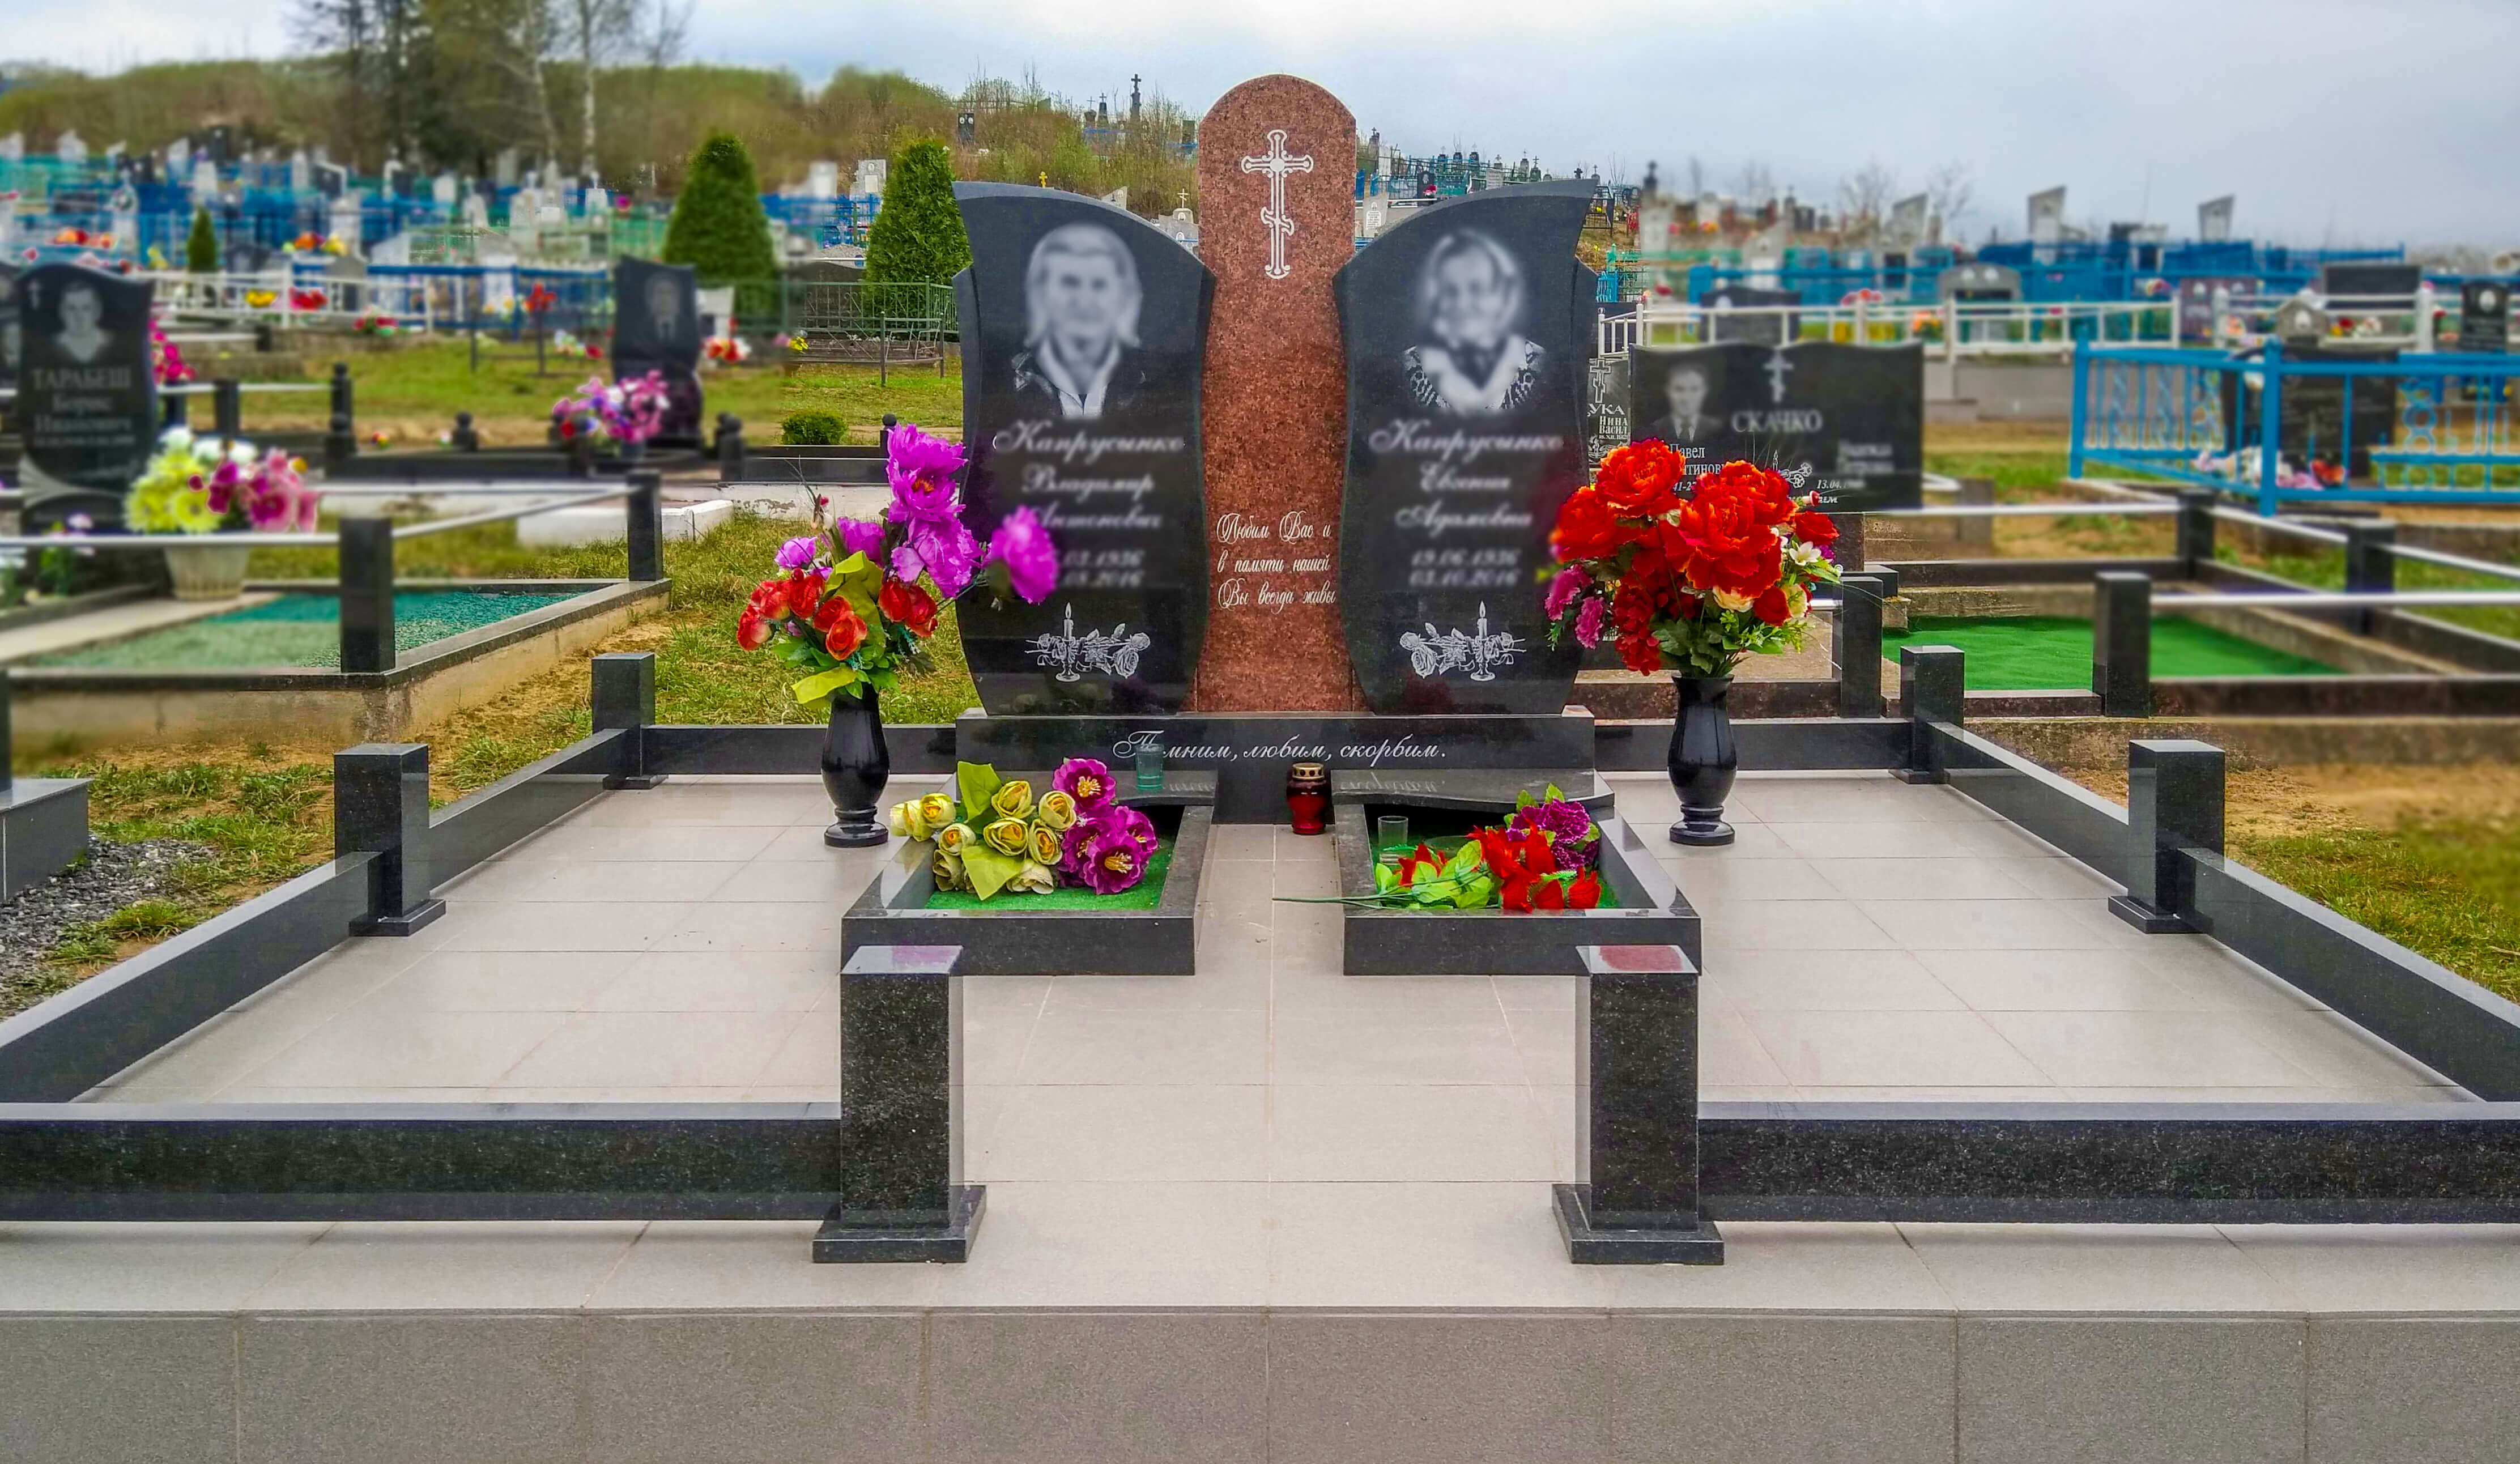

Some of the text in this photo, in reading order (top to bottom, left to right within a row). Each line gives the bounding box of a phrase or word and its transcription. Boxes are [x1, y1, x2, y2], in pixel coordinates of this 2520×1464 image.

[1587, 403, 1625, 417] УКА
[1731, 409, 1823, 433] СКАЧКО
[1021, 462, 1154, 504] Владимир
[1216, 510, 1332, 544] Любим Вас и
[1395, 499, 1533, 538] Адамовна
[1218, 550, 1330, 572] в памяти нашей
[1218, 578, 1336, 614] Вы всегда живы
[1113, 730, 1446, 767] Пмним, любим, скорбим.
